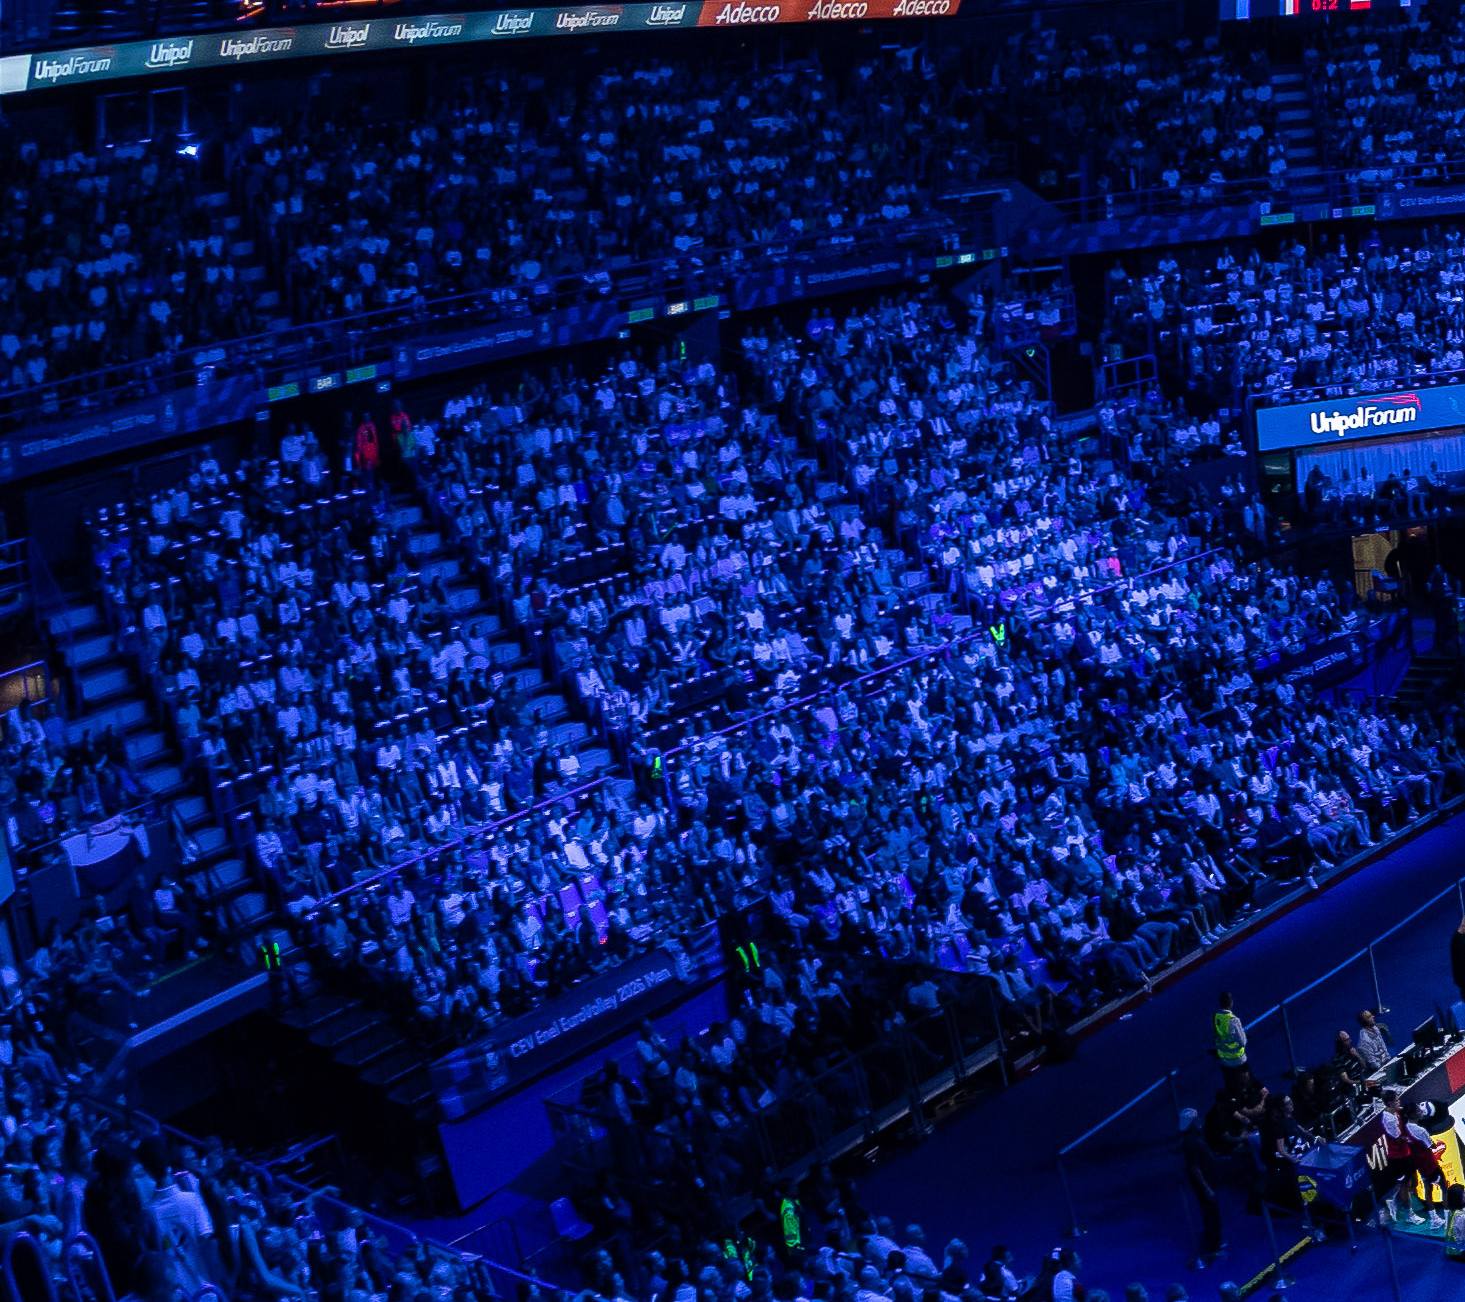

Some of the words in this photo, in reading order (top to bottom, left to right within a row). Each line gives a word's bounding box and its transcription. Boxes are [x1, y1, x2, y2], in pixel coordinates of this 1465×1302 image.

[716, 2, 780, 24] Adecco
[808, 0, 869, 21] Adecco
[34, 57, 111, 82] UnipolForum
[150, 40, 193, 64] Unipol
[220, 37, 292, 61] UnipolForum
[329, 24, 369, 45] Unipol
[650, 4, 686, 23] Unipol
[1310, 405, 1415, 436] UnipolForum
